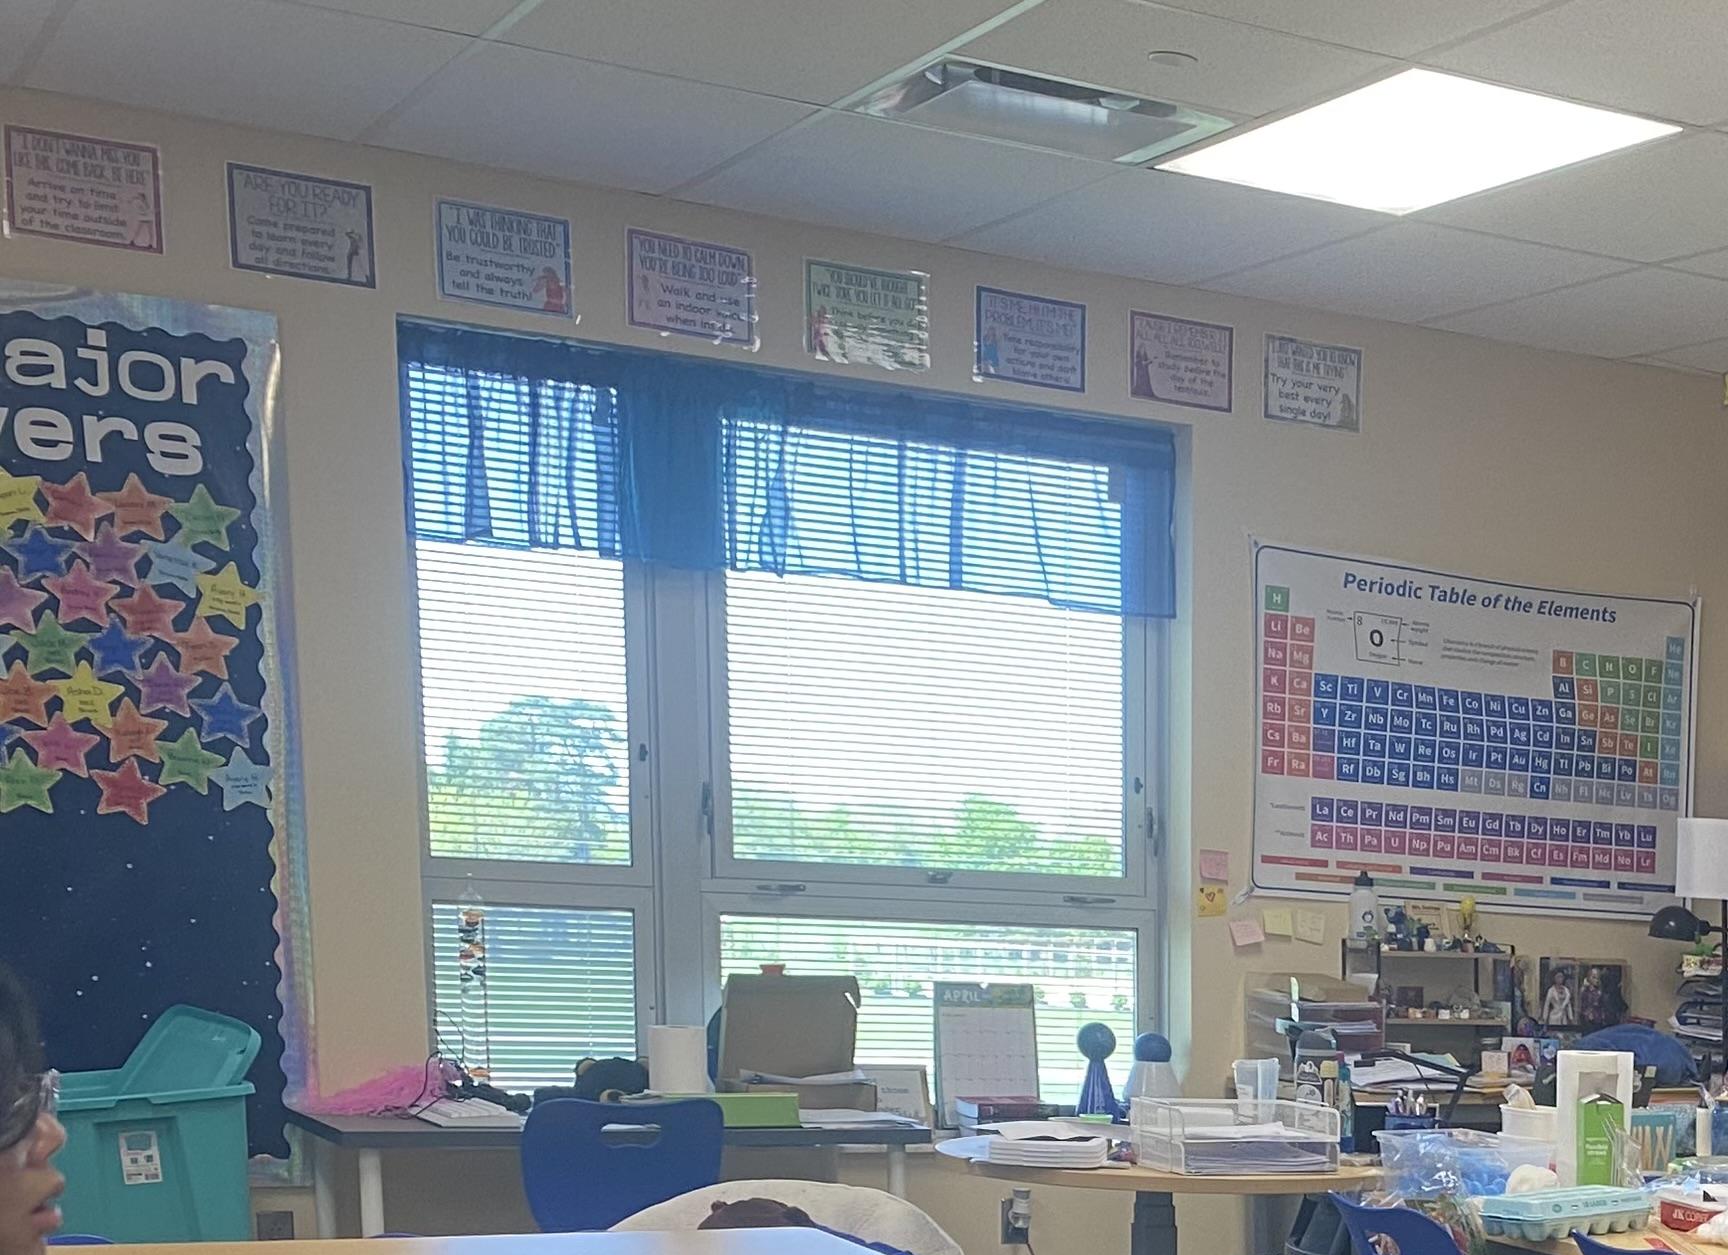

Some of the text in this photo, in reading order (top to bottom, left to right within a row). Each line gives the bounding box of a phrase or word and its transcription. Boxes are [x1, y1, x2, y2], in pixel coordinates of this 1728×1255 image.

[281, 181, 360, 208] YOU READY
[445, 224, 466, 243] YOU
[469, 228, 499, 250] COULD
[502, 235, 514, 252] BE
[446, 250, 536, 277] Be trustworthy
[459, 269, 523, 287] and always
[452, 280, 469, 291] tell
[476, 284, 495, 296] the
[660, 282, 716, 302] Walk and
[657, 299, 712, 314] an indoor
[666, 315, 696, 327] when
[1270, 372, 1340, 394] Try your very
[1278, 390, 1332, 408] best every
[1279, 404, 1306, 419] single
[0, 407, 203, 476] ers
[1273, 593, 1281, 604] H
[1343, 572, 1617, 624] Periodic Table of the Elements
[1271, 620, 1281, 631] Li
[1356, 616, 1363, 626] 8
[1370, 629, 1384, 647] O
[1271, 676, 1278, 686] K
[1347, 684, 1357, 694] Ti
[1559, 683, 1569, 693] Al
[1396, 690, 1408, 700] Cr
[1465, 698, 1479, 709] Co
[1490, 700, 1501, 711] Ni
[1512, 703, 1525, 714] Cu
[1536, 705, 1549, 716] Zn
[1267, 730, 1280, 740] Cs
[1513, 729, 1527, 742] Ag
[1537, 730, 1550, 742] Cd
[1581, 735, 1593, 745] Sn
[1490, 750, 1502, 762] Pt
[1512, 753, 1525, 765] Au
[1316, 804, 1329, 815] La
[1388, 810, 1404, 821] Nd
[943, 989, 981, 1003] APRIL
[1672, 1209, 1685, 1220] JK
